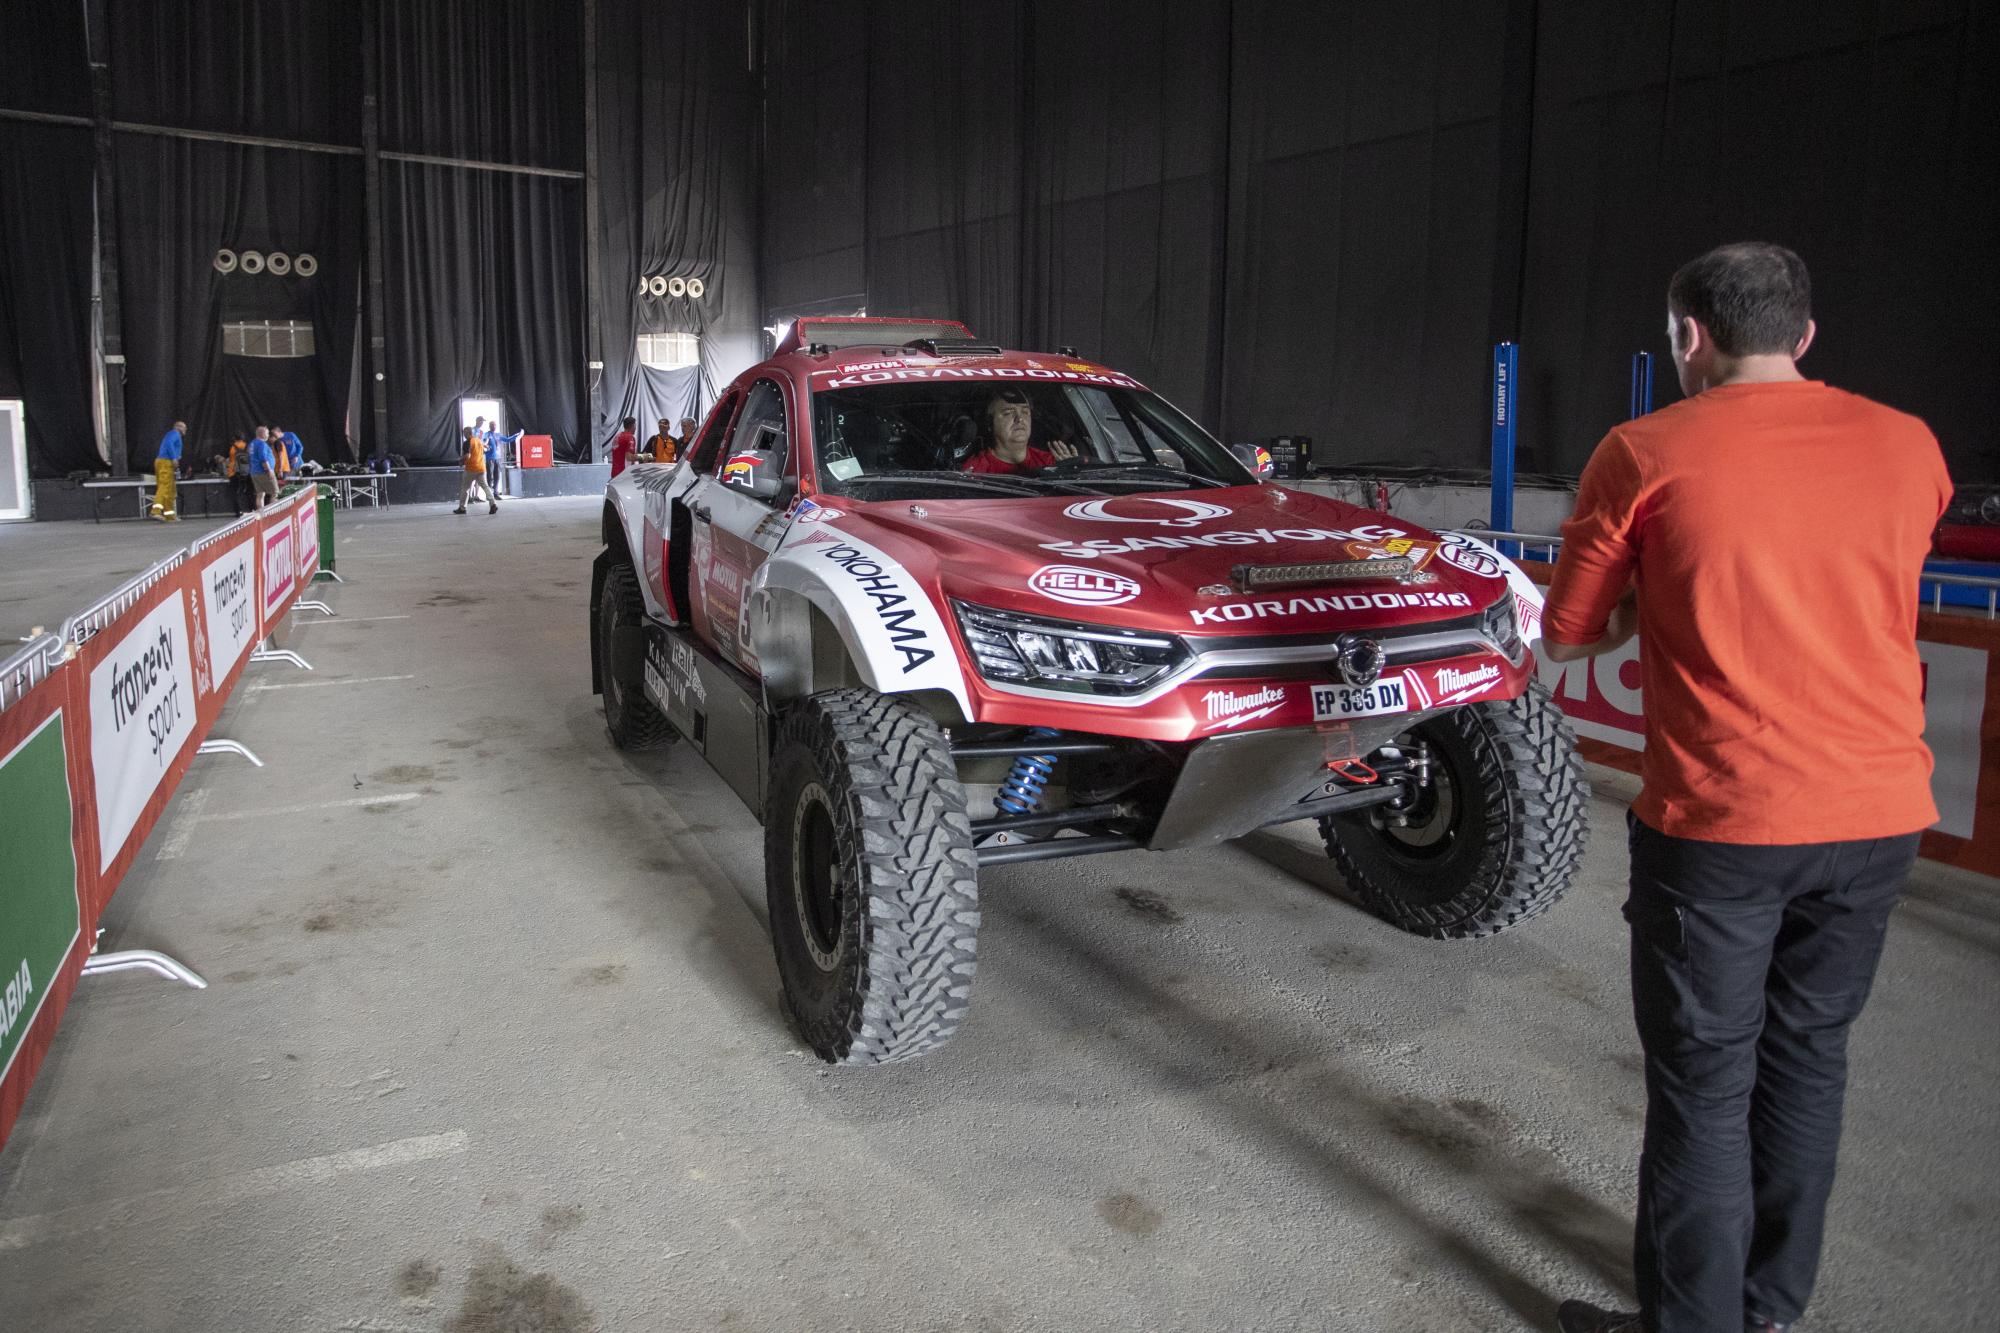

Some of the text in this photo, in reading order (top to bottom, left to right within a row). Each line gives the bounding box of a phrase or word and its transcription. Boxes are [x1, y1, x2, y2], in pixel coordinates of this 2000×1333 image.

[844, 361, 902, 372] MOTUL
[1497, 362, 1506, 421] ROTARY LIFT
[1037, 525, 1407, 559] SSANGYONG
[267, 535, 292, 597] MOTUL
[711, 561, 738, 593] MOTUL
[1038, 573, 1141, 596] HELLA
[231, 599, 248, 648] sport
[816, 543, 936, 674] YOKOHAMA
[1189, 593, 1399, 625] KORANDO
[648, 639, 687, 706] KARBIUM
[1433, 665, 1500, 695] Milwaukee
[1201, 685, 1285, 720] Milwaukee
[1314, 690, 1336, 715] EP
[1378, 683, 1404, 708] DX
[148, 674, 181, 768] sport
